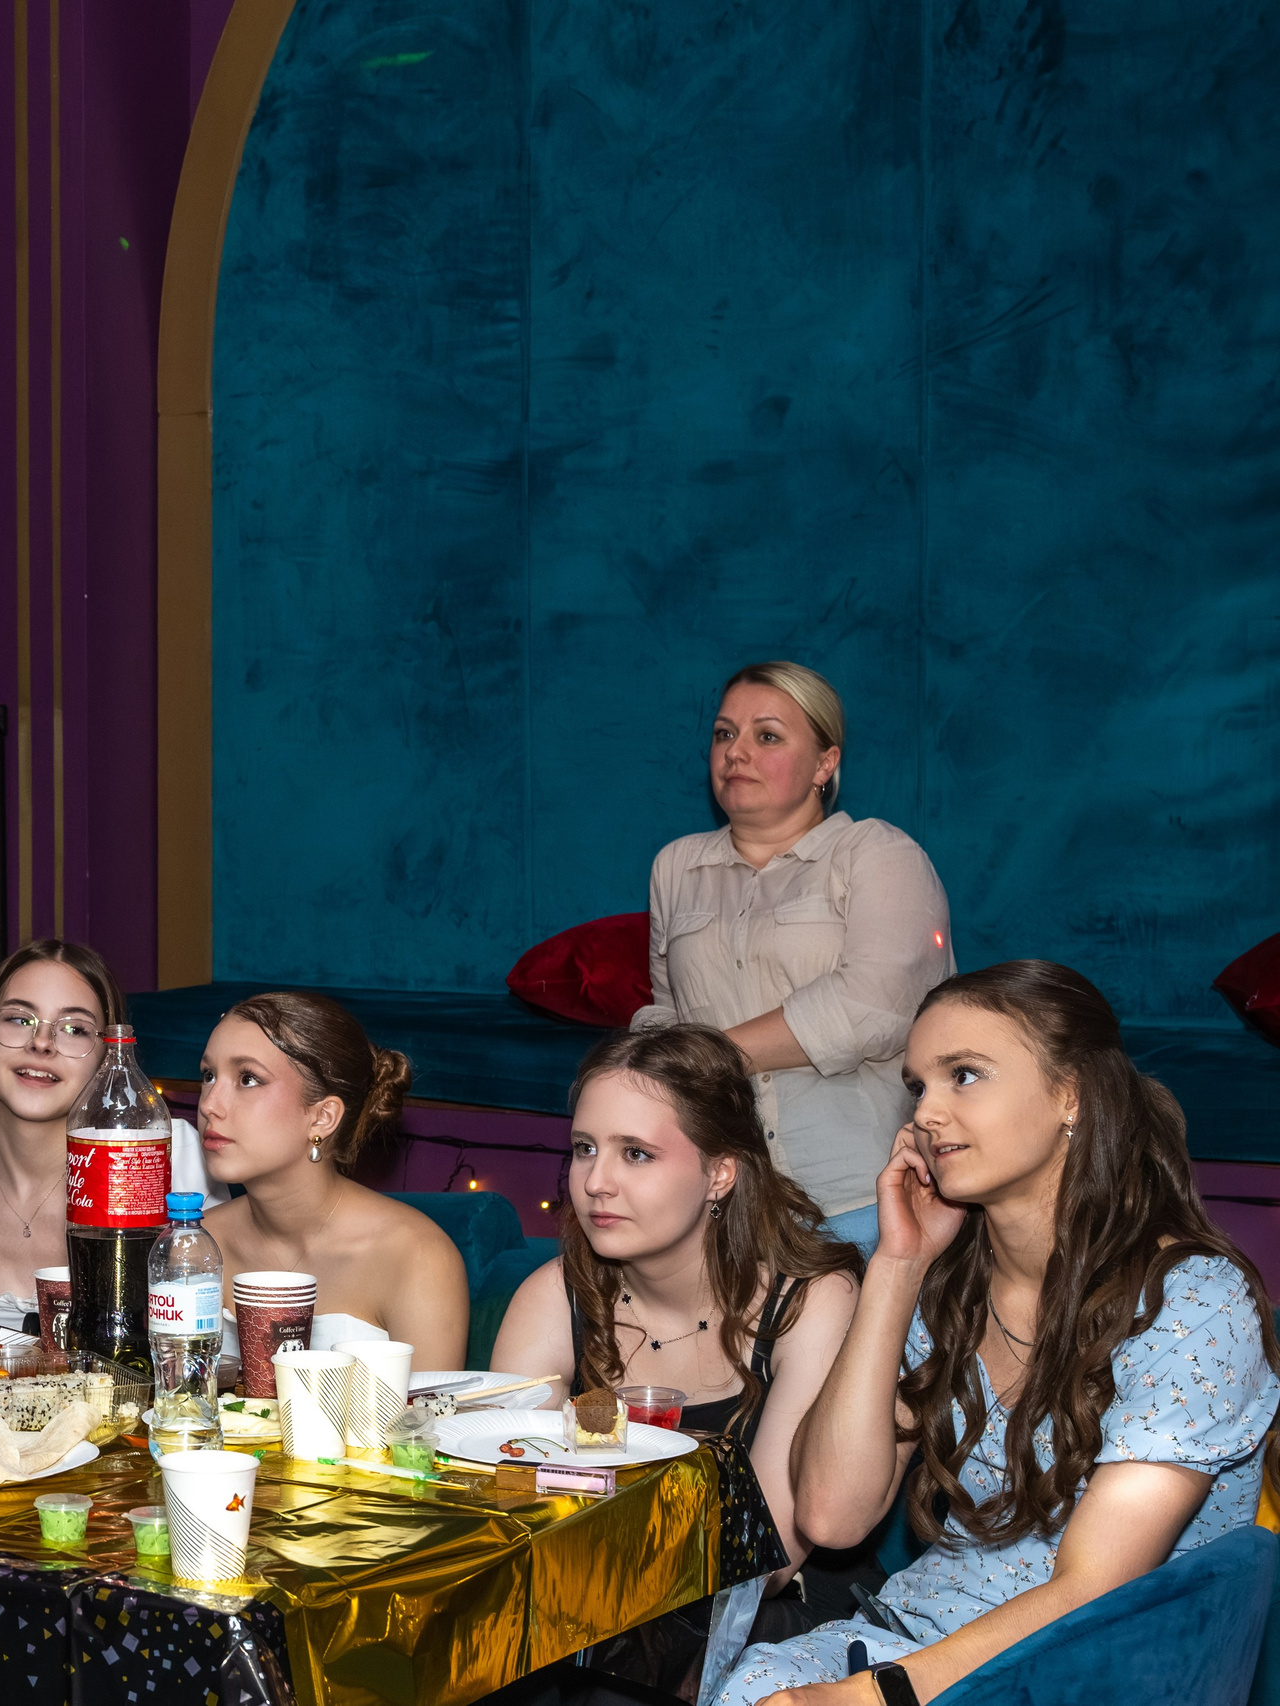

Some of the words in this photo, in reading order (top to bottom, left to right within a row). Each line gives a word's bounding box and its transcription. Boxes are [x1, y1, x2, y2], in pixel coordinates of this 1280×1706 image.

[67, 1148, 96, 1167] port
[67, 1169, 85, 1193] yle
[71, 1188, 93, 1207] Cola
[148, 1294, 174, 1307] ЯТОЙ
[149, 1307, 183, 1321] ОЧНИК
